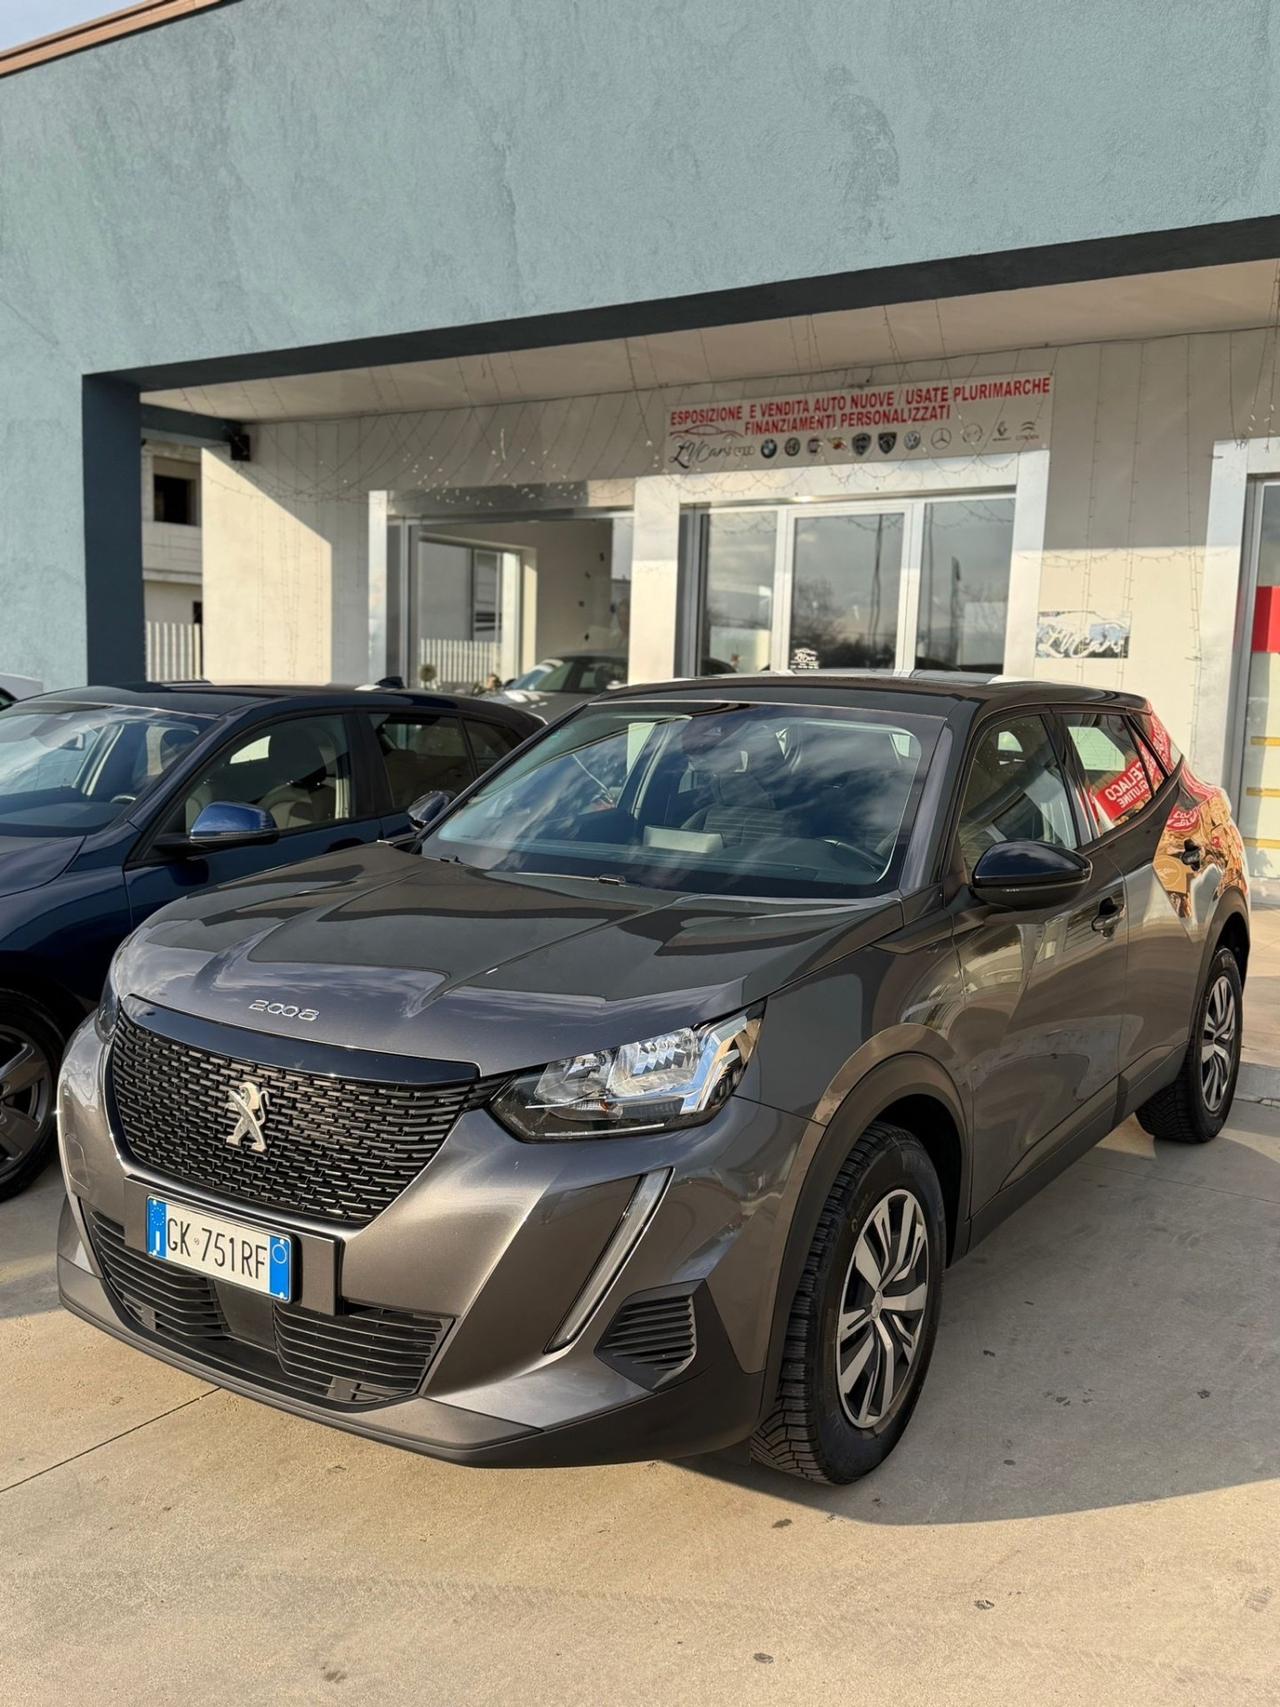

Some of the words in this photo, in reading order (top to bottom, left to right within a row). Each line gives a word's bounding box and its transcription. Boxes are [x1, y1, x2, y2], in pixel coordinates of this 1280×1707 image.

[670, 406, 743, 426] ESPOSIZIONE
[749, 404, 757, 419] E
[760, 399, 809, 418] VENDITA
[814, 395, 847, 413] AUTO
[850, 391, 895, 409] NUOVE
[906, 385, 949, 405] USATE
[953, 377, 1051, 402] PLURIMARCHE
[744, 414, 837, 436] FINANZIAMENTI
[840, 404, 951, 428] PERSONALIZZATI
[248, 1000, 320, 1021] 2008
